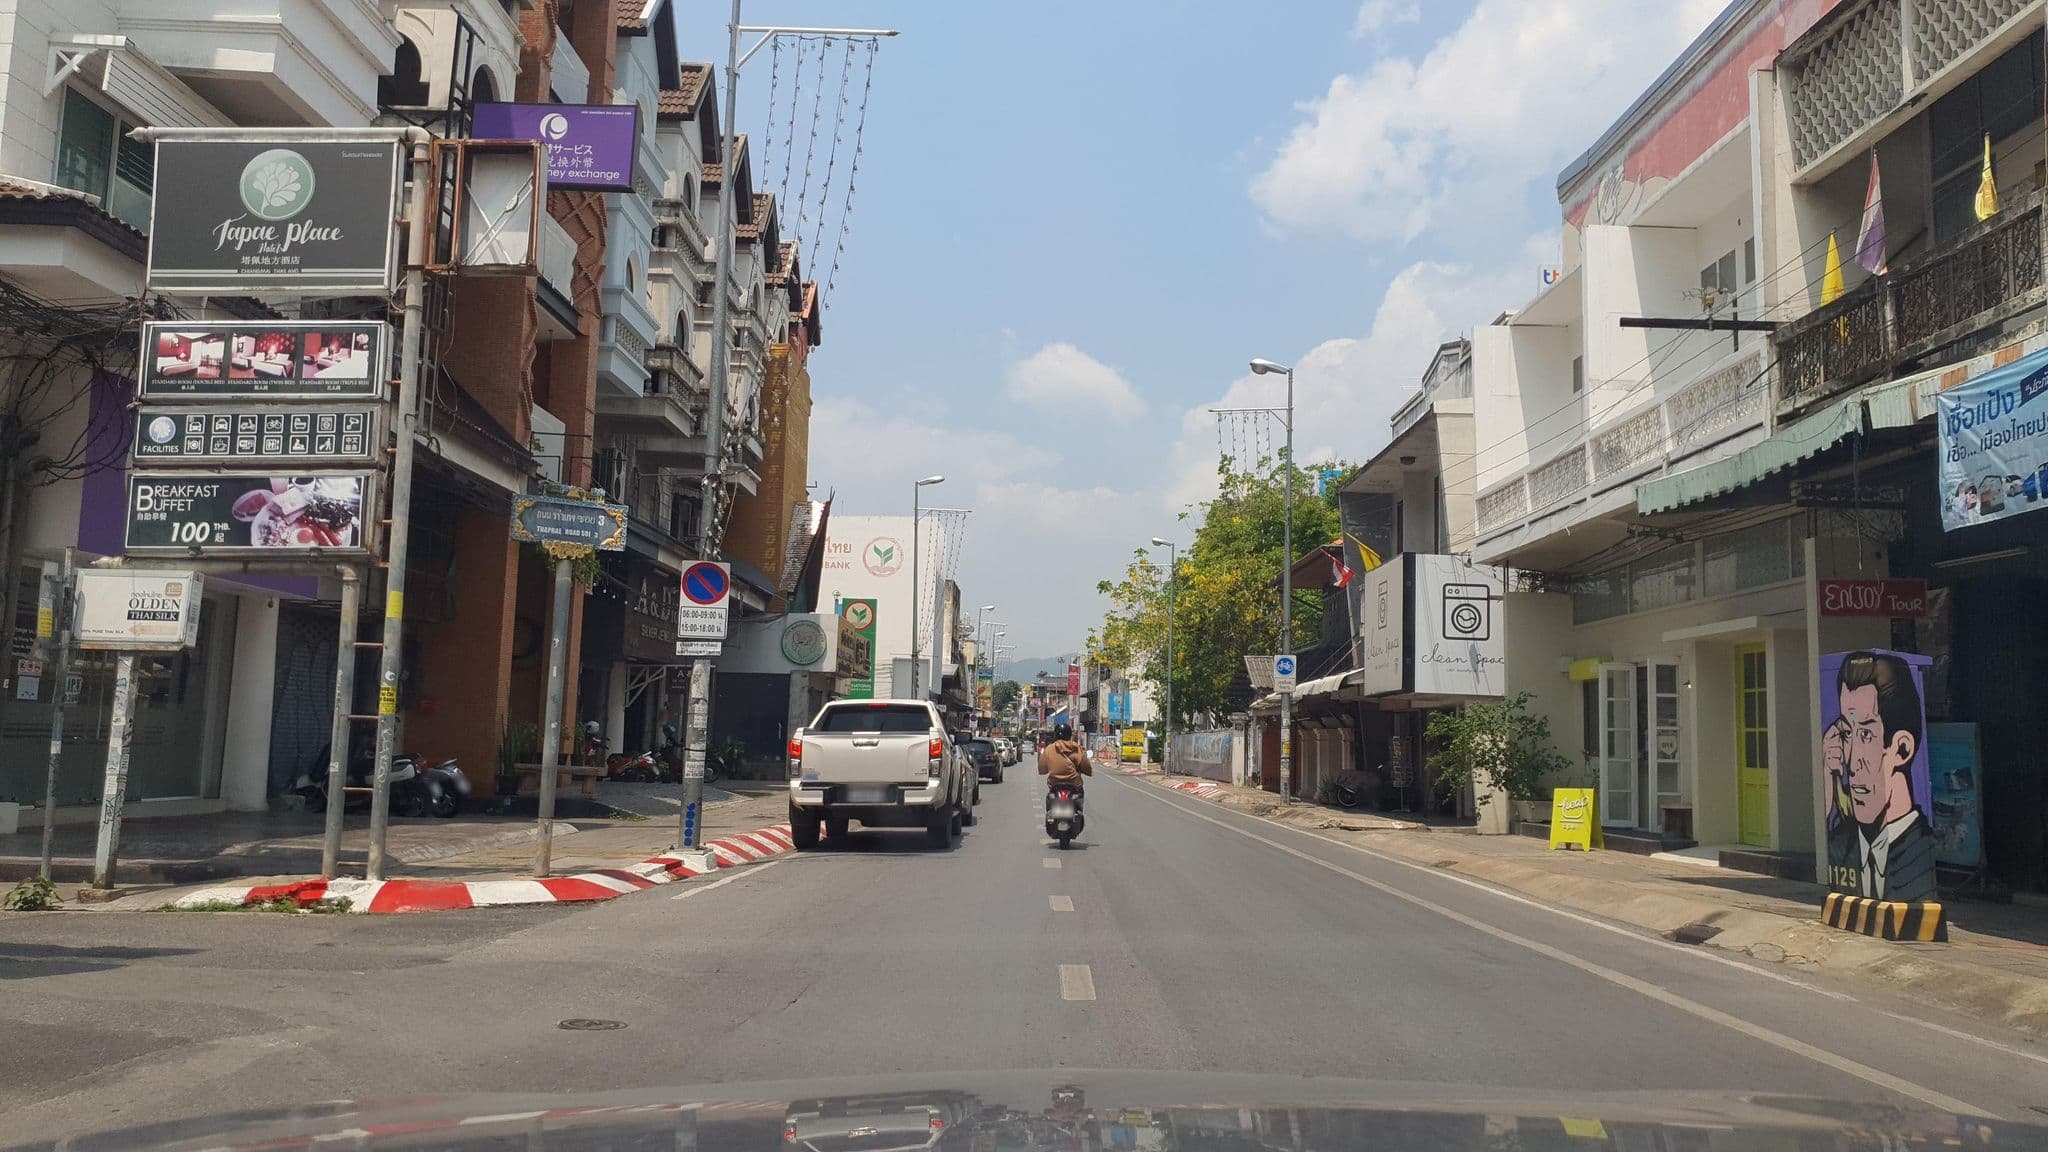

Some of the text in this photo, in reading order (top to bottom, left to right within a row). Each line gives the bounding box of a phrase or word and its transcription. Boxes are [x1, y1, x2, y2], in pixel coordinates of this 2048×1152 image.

[548, 169, 620, 181] ney exchange
[212, 212, 344, 253] Tapae Place
[143, 445, 179, 453] FACILITIES
[598, 515, 605, 526] 3
[172, 521, 211, 543] 100
[130, 611, 153, 619] THAI
